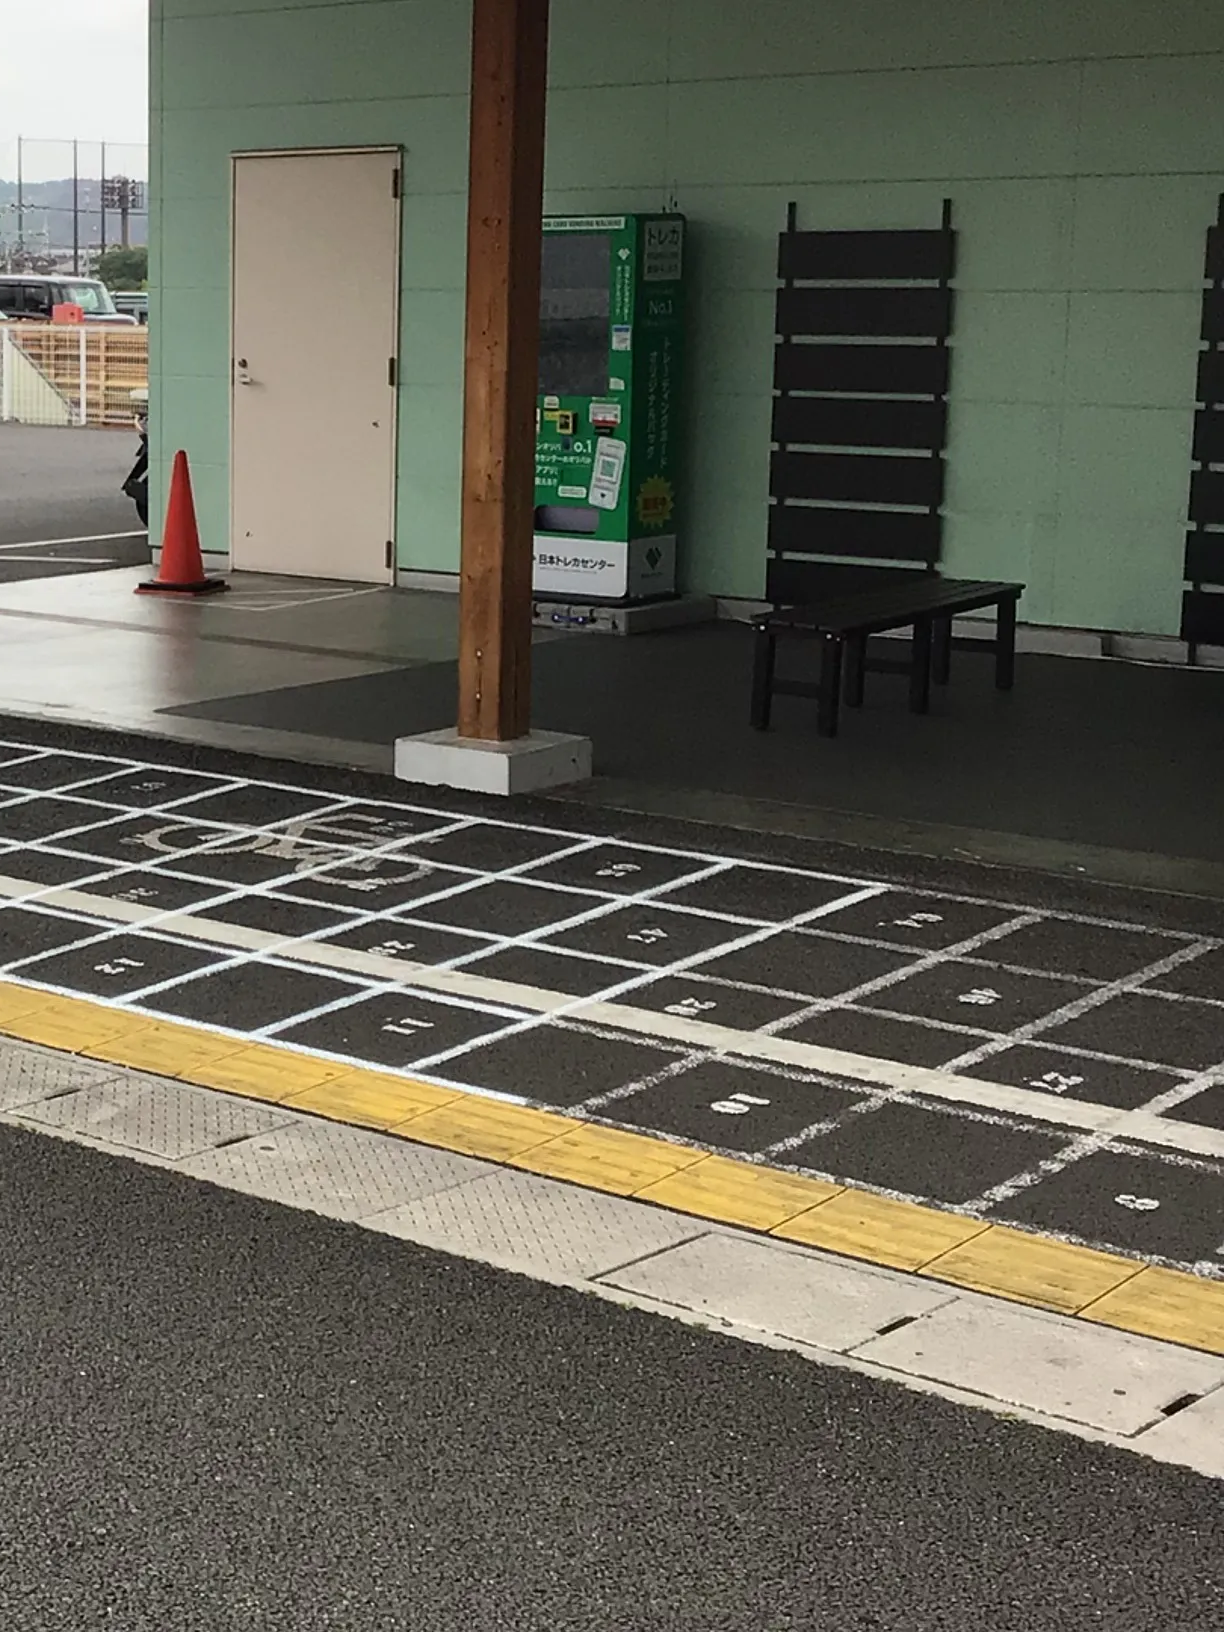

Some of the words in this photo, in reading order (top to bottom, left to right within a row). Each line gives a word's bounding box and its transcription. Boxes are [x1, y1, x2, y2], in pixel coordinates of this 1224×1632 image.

[648, 226, 679, 246] トレカ
[539, 554, 615, 570] 日本トレカセンター
[382, 1018, 434, 1034] 11
[711, 1093, 770, 1114] 10
